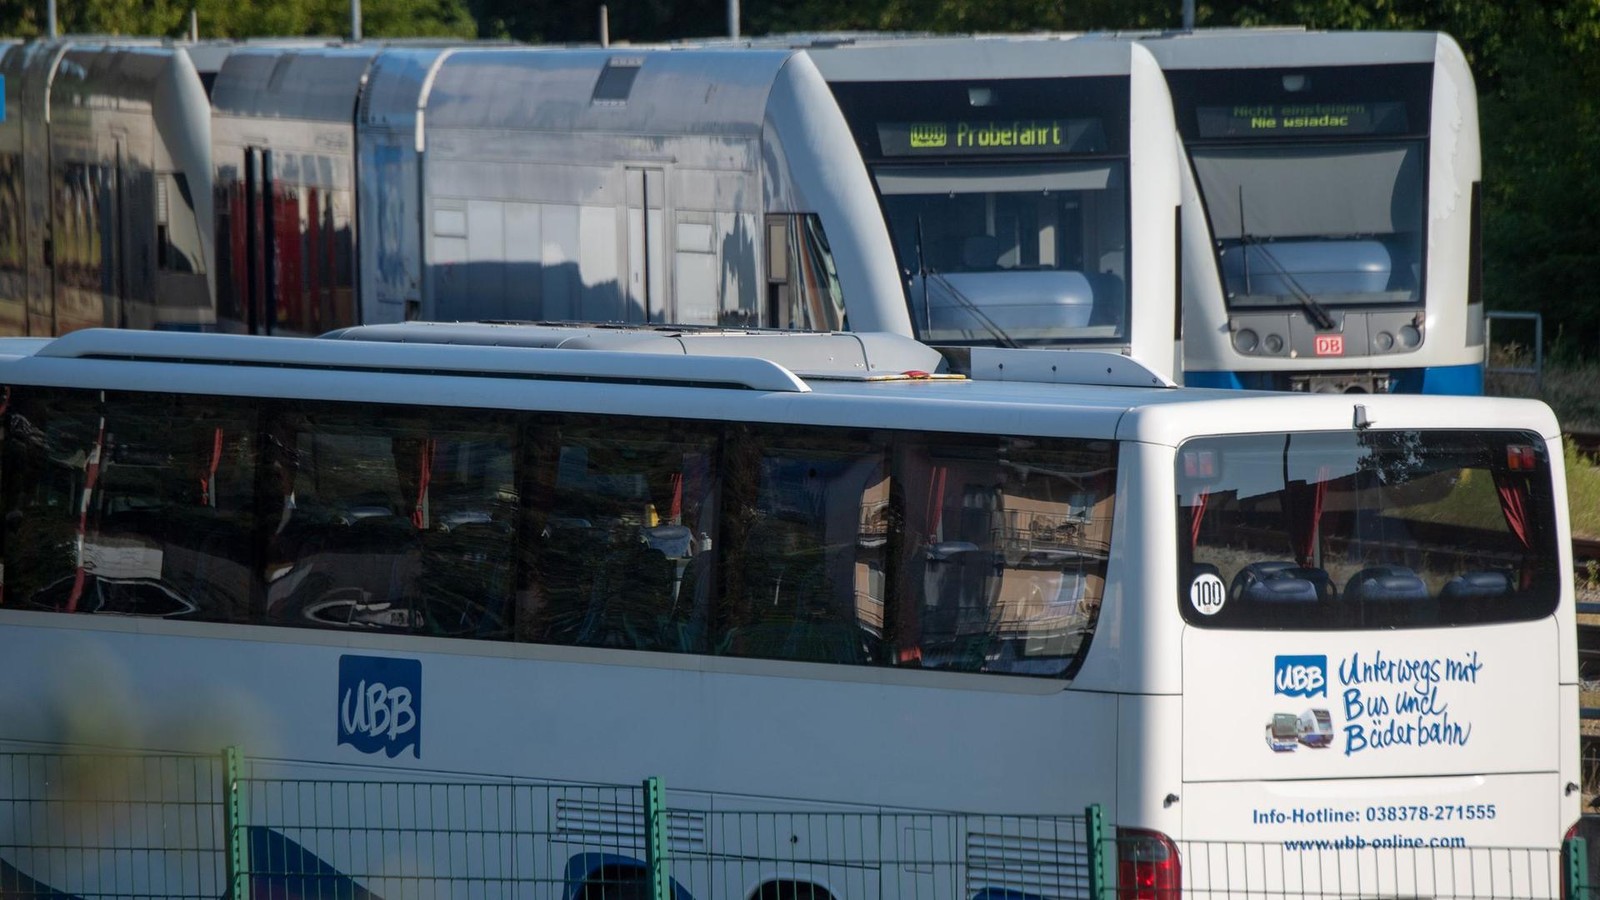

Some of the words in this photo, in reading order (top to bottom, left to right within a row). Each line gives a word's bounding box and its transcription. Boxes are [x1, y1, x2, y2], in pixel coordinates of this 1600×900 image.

[1233, 105, 1273, 117] Nicht
[1251, 117, 1277, 129] Nie
[957, 121, 1061, 147] Probefahrt
[1194, 580, 1222, 607] 100
[1275, 664, 1325, 693] UBB
[1338, 650, 1441, 695] Unterwegs
[1445, 651, 1483, 684] mit
[341, 679, 416, 741] UBB
[1342, 687, 1390, 722] Bus
[1342, 711, 1472, 757] Bäderbahn
[1252, 807, 1361, 824] Info-Hotline:
[1365, 804, 1497, 823] 038378-271555
[1284, 834, 1467, 851] www.ubb-online.com
